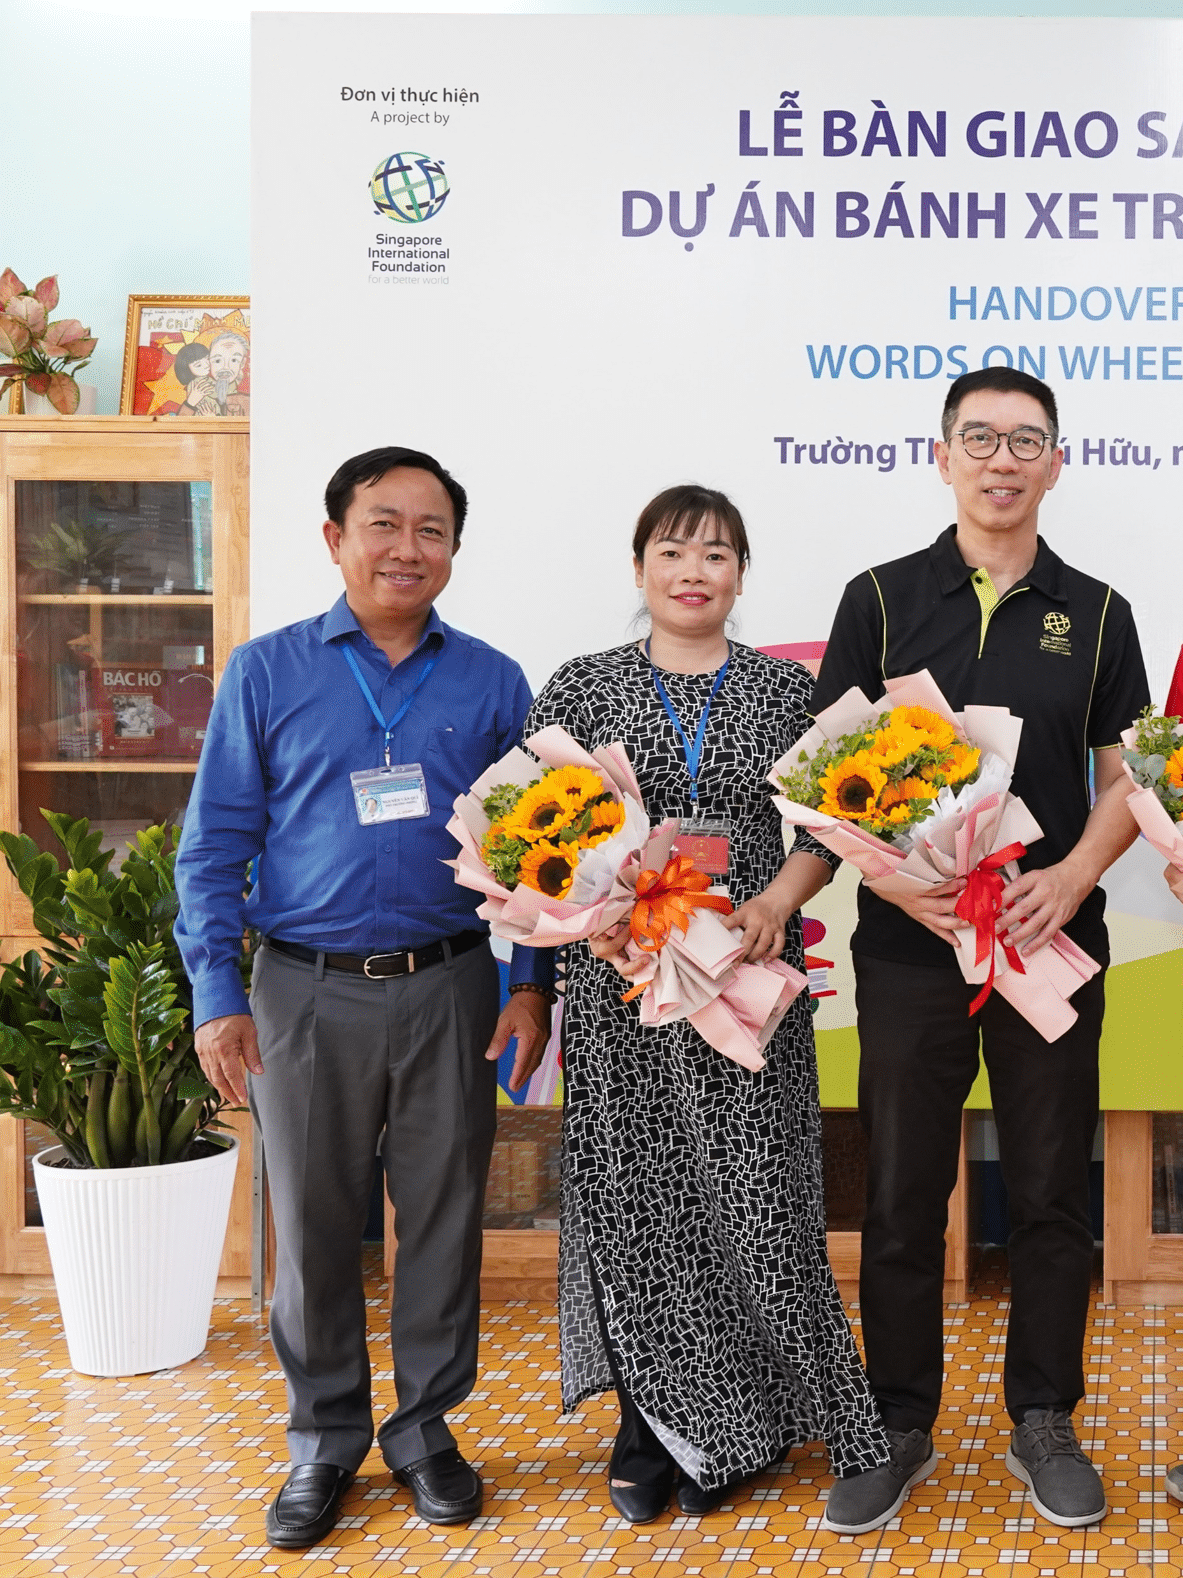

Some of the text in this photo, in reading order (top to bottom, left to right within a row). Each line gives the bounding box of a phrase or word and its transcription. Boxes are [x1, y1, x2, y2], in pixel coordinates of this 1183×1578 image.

[341, 87, 479, 106] Đơn vị thực hiện
[371, 111, 449, 126] A project by
[739, 91, 803, 156] LỄ
[823, 100, 946, 157] BÀN
[966, 111, 1118, 158] GIAO
[622, 183, 715, 252] DỰ
[729, 181, 814, 237] ÁN
[836, 181, 1005, 238] BÁNH
[1025, 193, 1098, 239] XE
[375, 234, 443, 250] Singapore
[368, 248, 449, 260] International
[372, 261, 445, 273] Foundation
[369, 275, 380, 283] for
[393, 276, 419, 284] better
[423, 276, 449, 284] world
[806, 344, 968, 380] WORDS
[982, 345, 1046, 380] ON
[774, 436, 897, 474] Trường
[1083, 438, 1161, 470] Hữu,
[103, 670, 136, 687] BÁC
